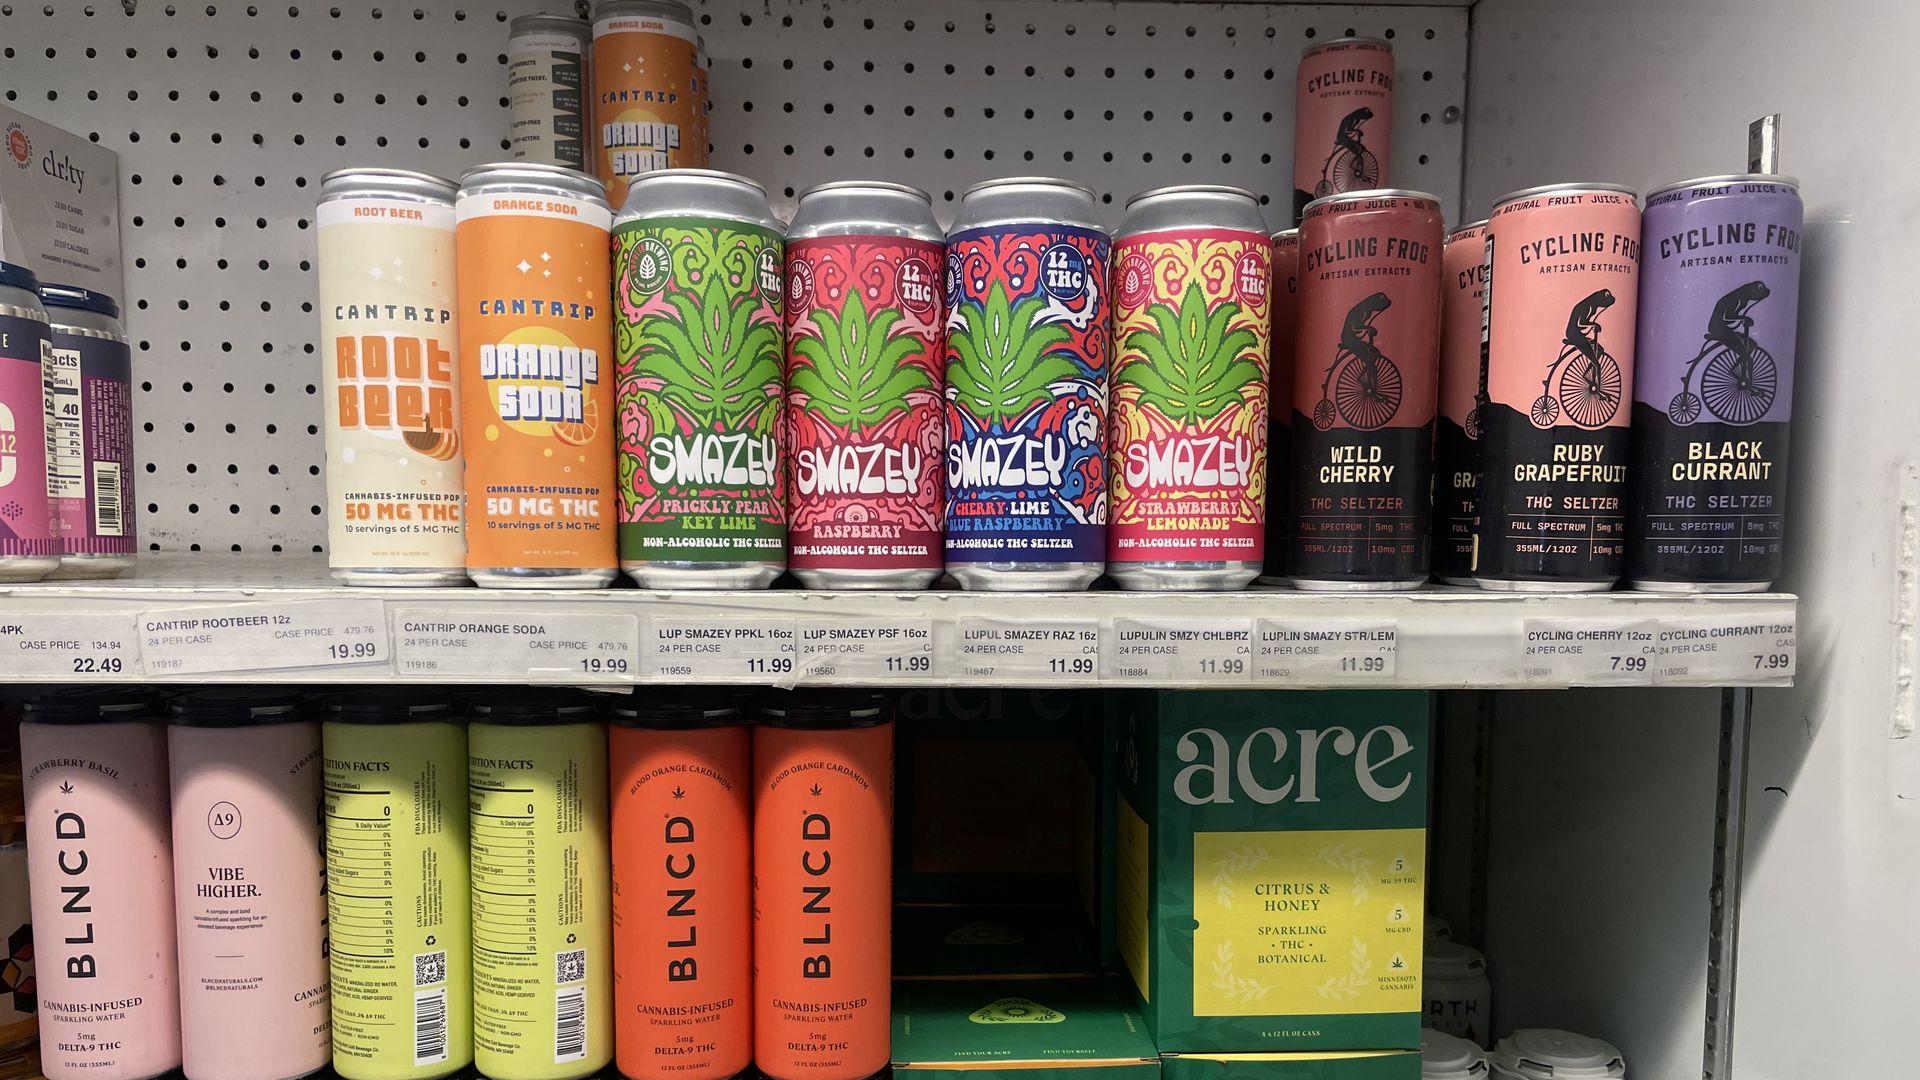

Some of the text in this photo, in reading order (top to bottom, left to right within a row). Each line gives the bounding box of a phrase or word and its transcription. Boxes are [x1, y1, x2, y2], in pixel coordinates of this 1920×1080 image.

[608, 20, 663, 30] ORANGE SODA
[1308, 69, 1365, 93] CYCLING
[602, 90, 677, 104] CANTRIP
[613, 152, 668, 176] SODA
[493, 200, 578, 216] ORANGE SODA
[1505, 196, 1621, 213] NATURAL FRUIT JUICE
[354, 208, 422, 220] ROOT BEER
[1660, 222, 1800, 259] CYCLING FROG
[1048, 251, 1068, 269] 12
[1307, 237, 1428, 272] CYCLING FROG
[761, 254, 773, 272] 12
[1242, 259, 1256, 275] 12
[1540, 264, 1631, 274] ARTISAN EXTRACTS
[903, 265, 920, 282] 12
[1047, 270, 1081, 288] THC
[761, 271, 780, 293] THC
[1241, 276, 1264, 295] THC
[902, 282, 930, 302] THC
[336, 304, 450, 324] CANTRIP
[480, 299, 595, 321] CANTRIP
[63, 404, 78, 415] 40
[498, 385, 584, 423] SODA
[1331, 446, 1382, 464] WILD
[1554, 445, 1604, 462] RUBY
[1688, 441, 1763, 460] BLACK
[650, 433, 776, 486] SMAZEY
[949, 434, 1066, 489] SMAZEY
[1126, 435, 1251, 488] SMAZEY
[798, 443, 920, 495] SMAZEY
[1320, 466, 1394, 483] CHERRY
[1514, 464, 1626, 483] GRAPEFRUIT
[1672, 462, 1772, 481] CURRANT
[345, 492, 441, 501] CANNABIS-INFUSED
[486, 486, 583, 495] CANNABIS-INFUSED
[487, 498, 599, 517] 50 MG THC
[663, 500, 769, 515] PRICKLY PEAR
[956, 502, 1049, 516] CHERRY LIME
[1138, 502, 1239, 515] STRAWBERRY
[1311, 498, 1403, 510] THC SELTZER
[1526, 496, 1618, 510] THC SELTZER
[1666, 496, 1773, 508] THC SELTZER
[345, 503, 460, 520] 50 MG THC
[345, 524, 460, 534] 10 servings of 5 MG THC
[682, 516, 756, 530] KEY LIME
[949, 518, 1064, 532] BLUE RASPBERRY
[1147, 517, 1230, 530] LEMONADE
[1512, 522, 1532, 530] FULL
[1652, 523, 1675, 531] FULL
[813, 525, 902, 539] RASPBERRY
[643, 537, 782, 548] NON-ALCOHOLIC THC SELTZER
[794, 546, 928, 555] NON-ALCOHOLIC THC SELTZER
[146, 615, 291, 632] CANTRIP ROOTBEER 12z
[404, 622, 546, 635] CANTRIP ORANGE SODA
[659, 629, 793, 639] LUP SMAZEY PPKL 16oz
[1262, 631, 1394, 641] LUPLIN SMAZY STR/LEM
[1660, 624, 1793, 641] CYCLING CURRANT 12oz
[20, 640, 121, 650] CASE PRICE 134.94
[328, 643, 376, 660] 19.99
[73, 658, 122, 673] 22.49
[581, 658, 628, 673] 19.99
[747, 658, 792, 673] 11.99
[1753, 654, 1789, 669] 7.99
[661, 667, 691, 675] 119559
[806, 667, 835, 675] 119560
[29, 758, 119, 781] STRAWBERRY BASIL
[353, 762, 390, 772] FACTS
[1173, 724, 1414, 806] acre
[630, 764, 733, 795] BLOOD ORANGE CARDAMOM
[208, 867, 245, 881] VIBE
[56, 812, 96, 978] BLNCD
[197, 884, 262, 898] HIGHER.
[1255, 883, 1330, 895] CITRUS &
[665, 816, 697, 982] BLNCD
[1264, 900, 1320, 912] HONEY
[1258, 926, 1327, 935] SPARKLING
[1280, 940, 1305, 949] THC
[1258, 954, 1327, 964] BOTANICAL
[44, 997, 143, 1012] CANNABIS-INFUSED
[53, 1013, 125, 1023] SPARKLING WATER
[649, 1014, 721, 1026] SPARKLING WATER
[77, 1033, 96, 1041] 5mg
[58, 1042, 121, 1052] DELTA-9 THC
